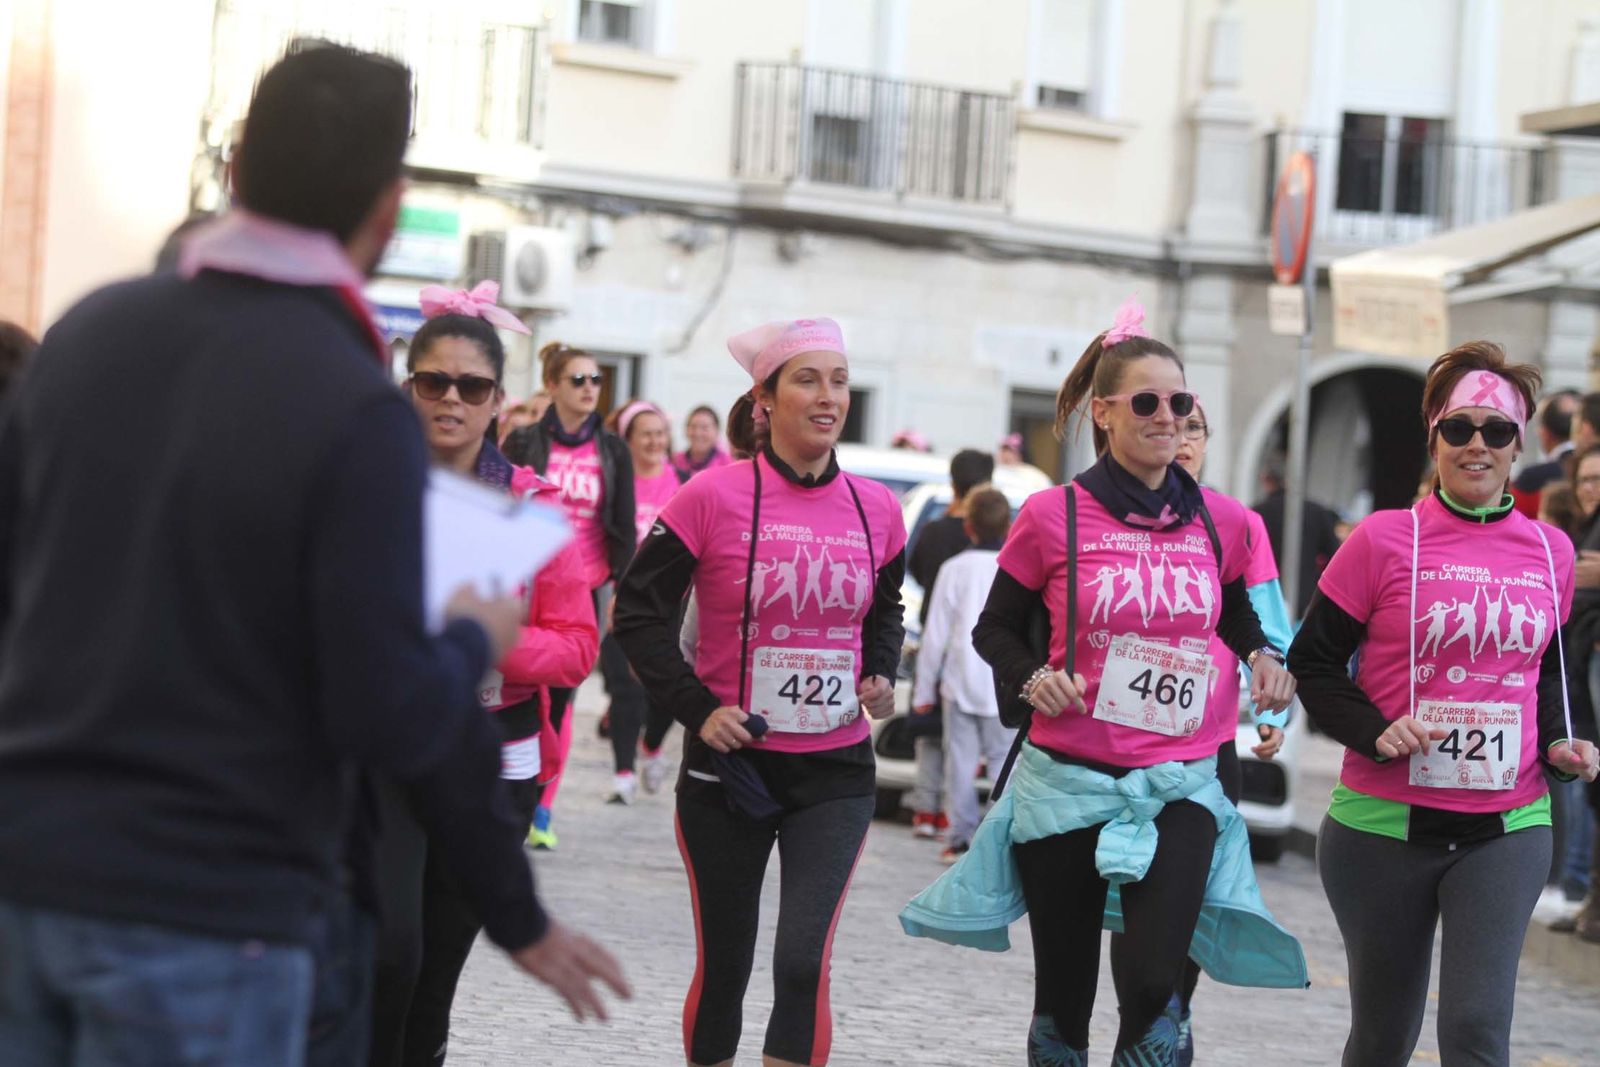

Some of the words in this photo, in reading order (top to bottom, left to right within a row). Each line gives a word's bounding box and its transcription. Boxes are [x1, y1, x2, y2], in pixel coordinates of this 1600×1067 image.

[763, 524, 812, 534] CARRERA
[759, 533, 774, 541] LA
[776, 533, 813, 543] MUJER
[824, 536, 868, 550] RUNNING
[1102, 533, 1151, 542] CARRERA
[1185, 534, 1206, 547] PINK
[1083, 543, 1097, 552] DE
[1100, 542, 1113, 550] LA
[1116, 542, 1152, 552] MUJER
[1163, 542, 1207, 556] RUNNING
[1442, 563, 1490, 575] CARRERA
[1421, 571, 1436, 580] DE
[1439, 571, 1453, 580] LA
[1455, 573, 1492, 584] MUJER
[1503, 576, 1546, 590] RUNNING
[777, 652, 814, 661] CARRERA
[1134, 644, 1173, 660] CARRERA
[760, 659, 771, 667] DE
[774, 661, 784, 669] LA
[787, 661, 814, 670] MUJER
[821, 662, 850, 671] RUNNING
[1115, 648, 1127, 658] DE
[1129, 651, 1139, 660] LA
[1142, 655, 1172, 668] MUJER
[1179, 663, 1206, 676] RUNNING
[778, 674, 842, 706] 422
[1128, 669, 1195, 710] 466
[1437, 707, 1476, 716] CARRERA
[1501, 709, 1518, 717] PINK
[1422, 713, 1433, 722] DE
[1434, 714, 1444, 723] LA
[1446, 716, 1476, 725] MUJER
[1484, 716, 1519, 726] RUNNING
[1437, 728, 1504, 762] 421
